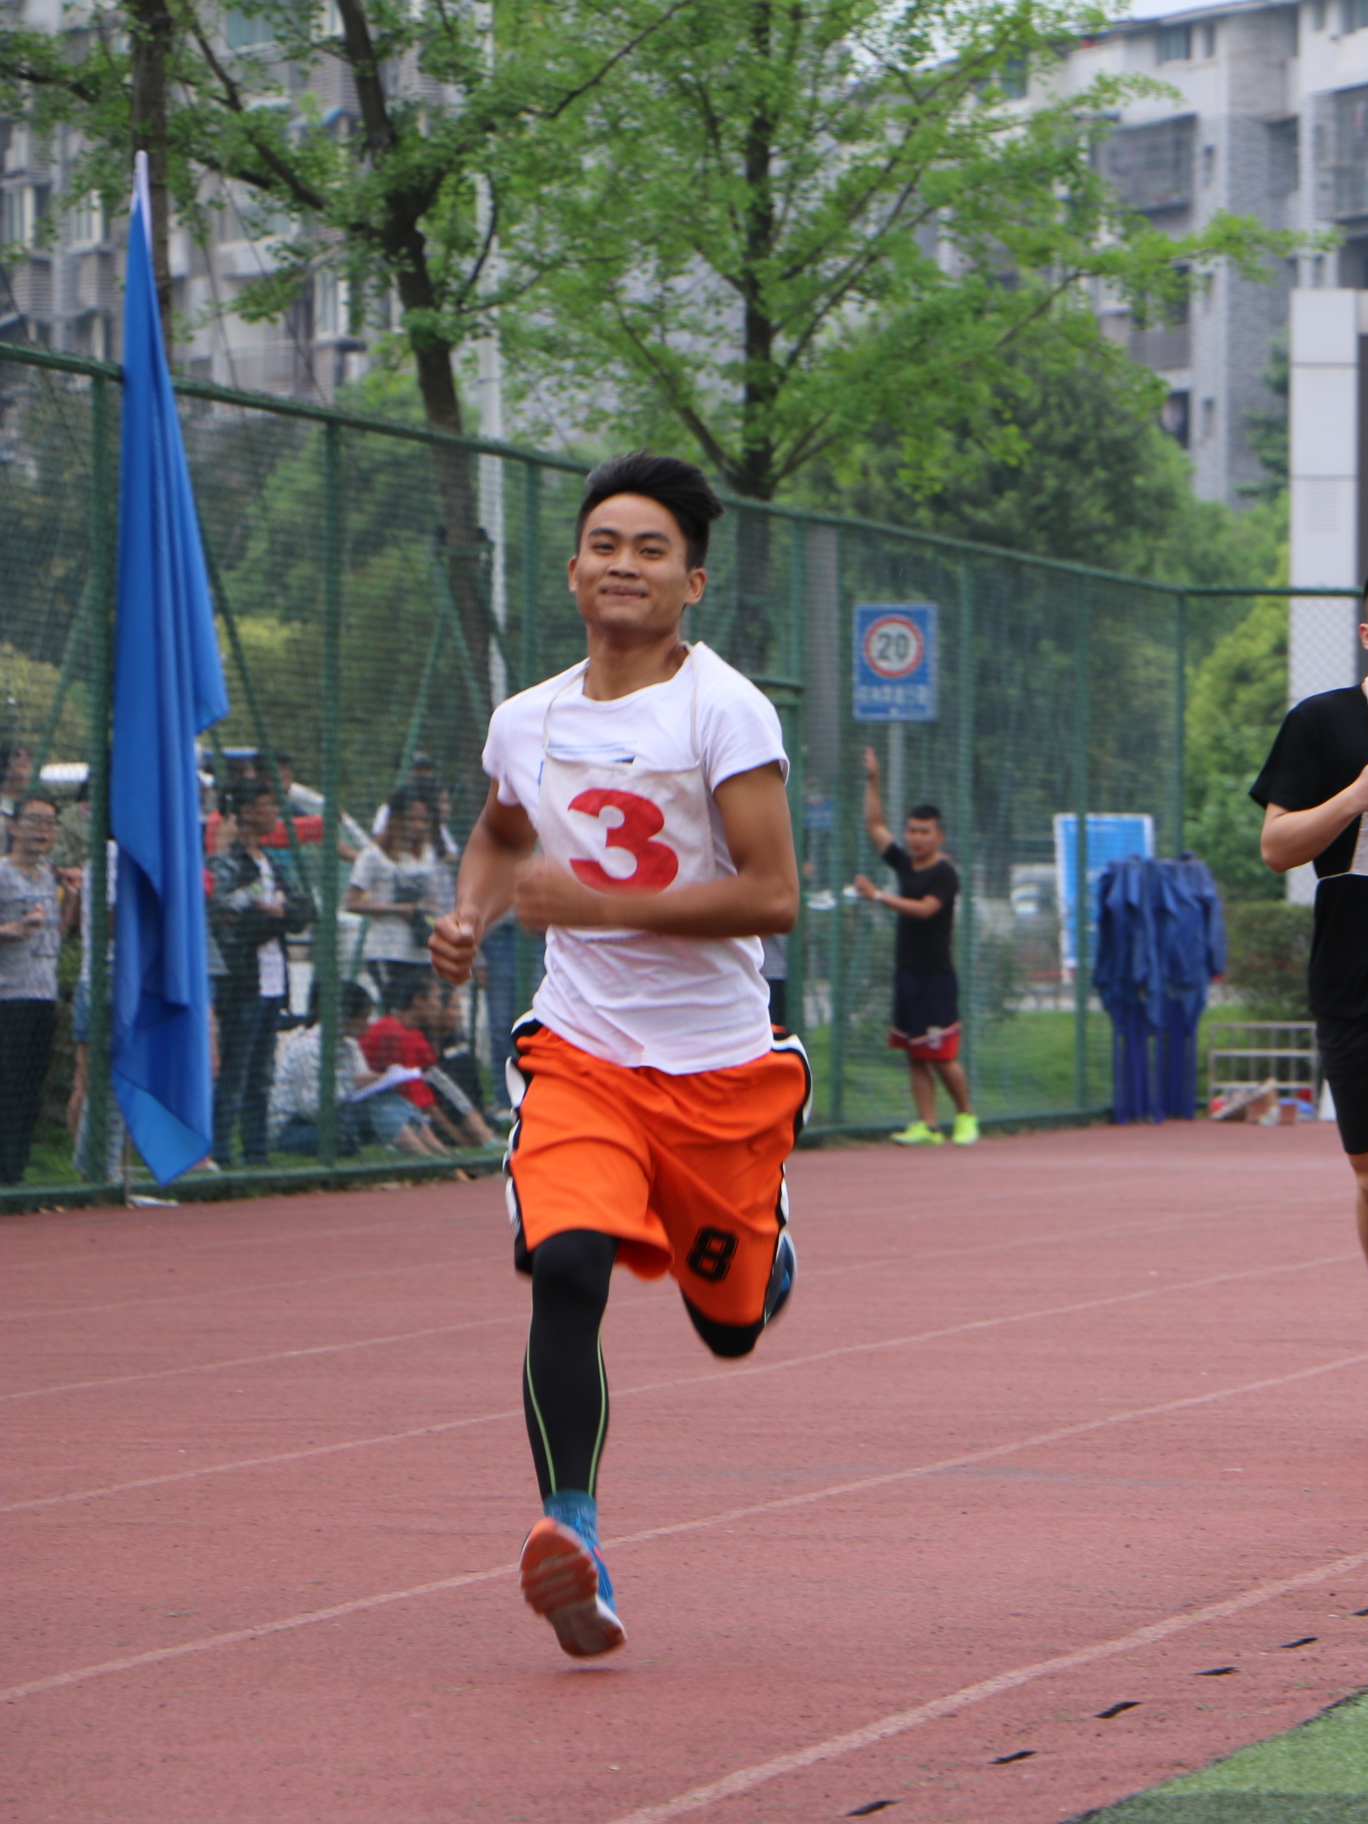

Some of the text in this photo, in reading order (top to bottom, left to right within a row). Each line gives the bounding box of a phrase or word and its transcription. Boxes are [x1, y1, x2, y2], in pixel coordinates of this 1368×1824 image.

[877, 632, 911, 660] 20
[568, 788, 679, 897] 3
[687, 1225, 738, 1285] 8
